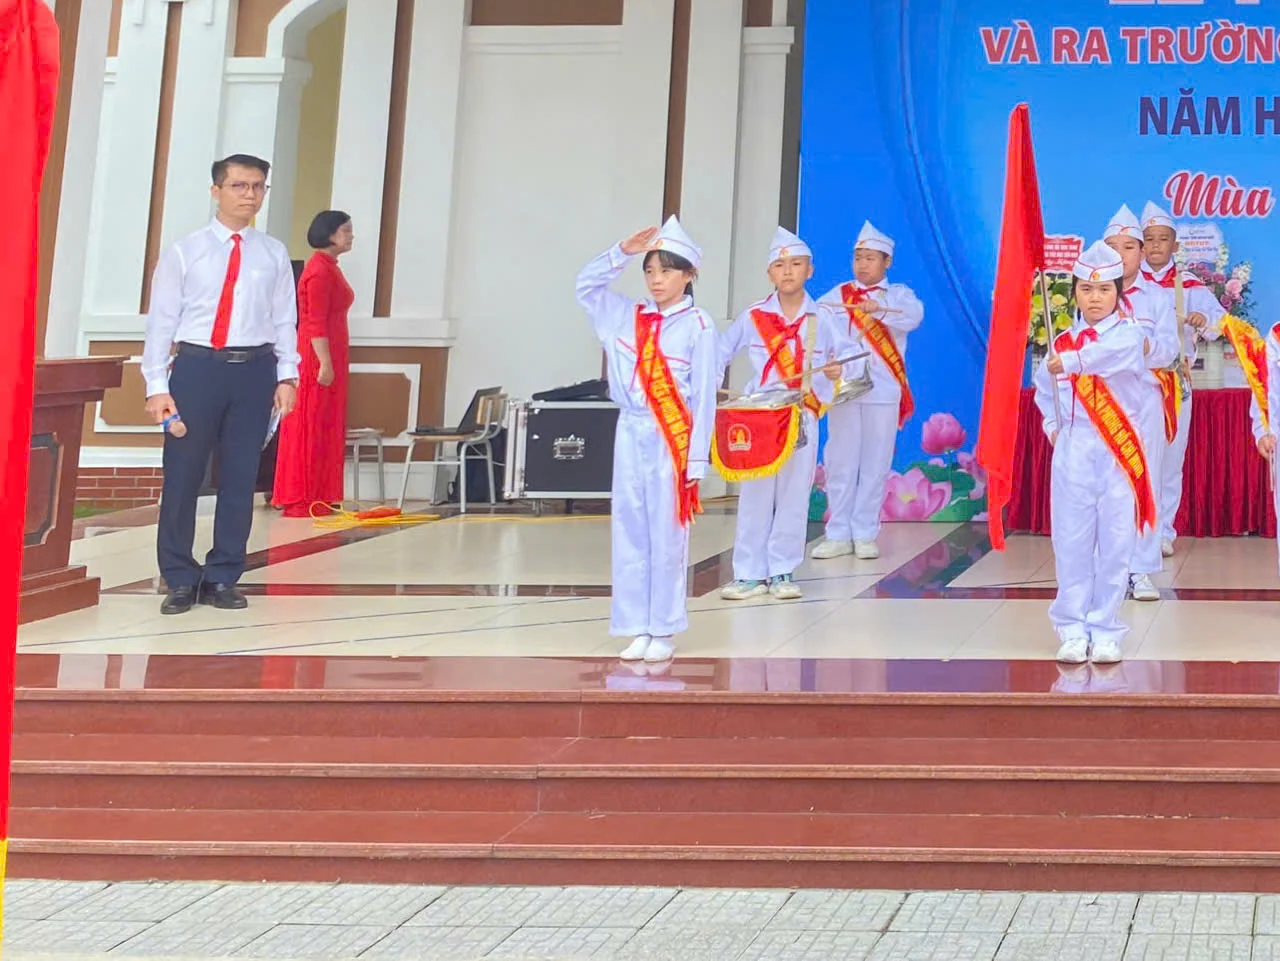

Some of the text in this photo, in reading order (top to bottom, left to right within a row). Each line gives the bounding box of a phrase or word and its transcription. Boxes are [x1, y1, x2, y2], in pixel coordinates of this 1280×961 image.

[980, 21, 1040, 64] VÀ
[1051, 26, 1111, 64] RA
[1139, 87, 1241, 136] NĂM
[1165, 171, 1273, 218] Mùa
